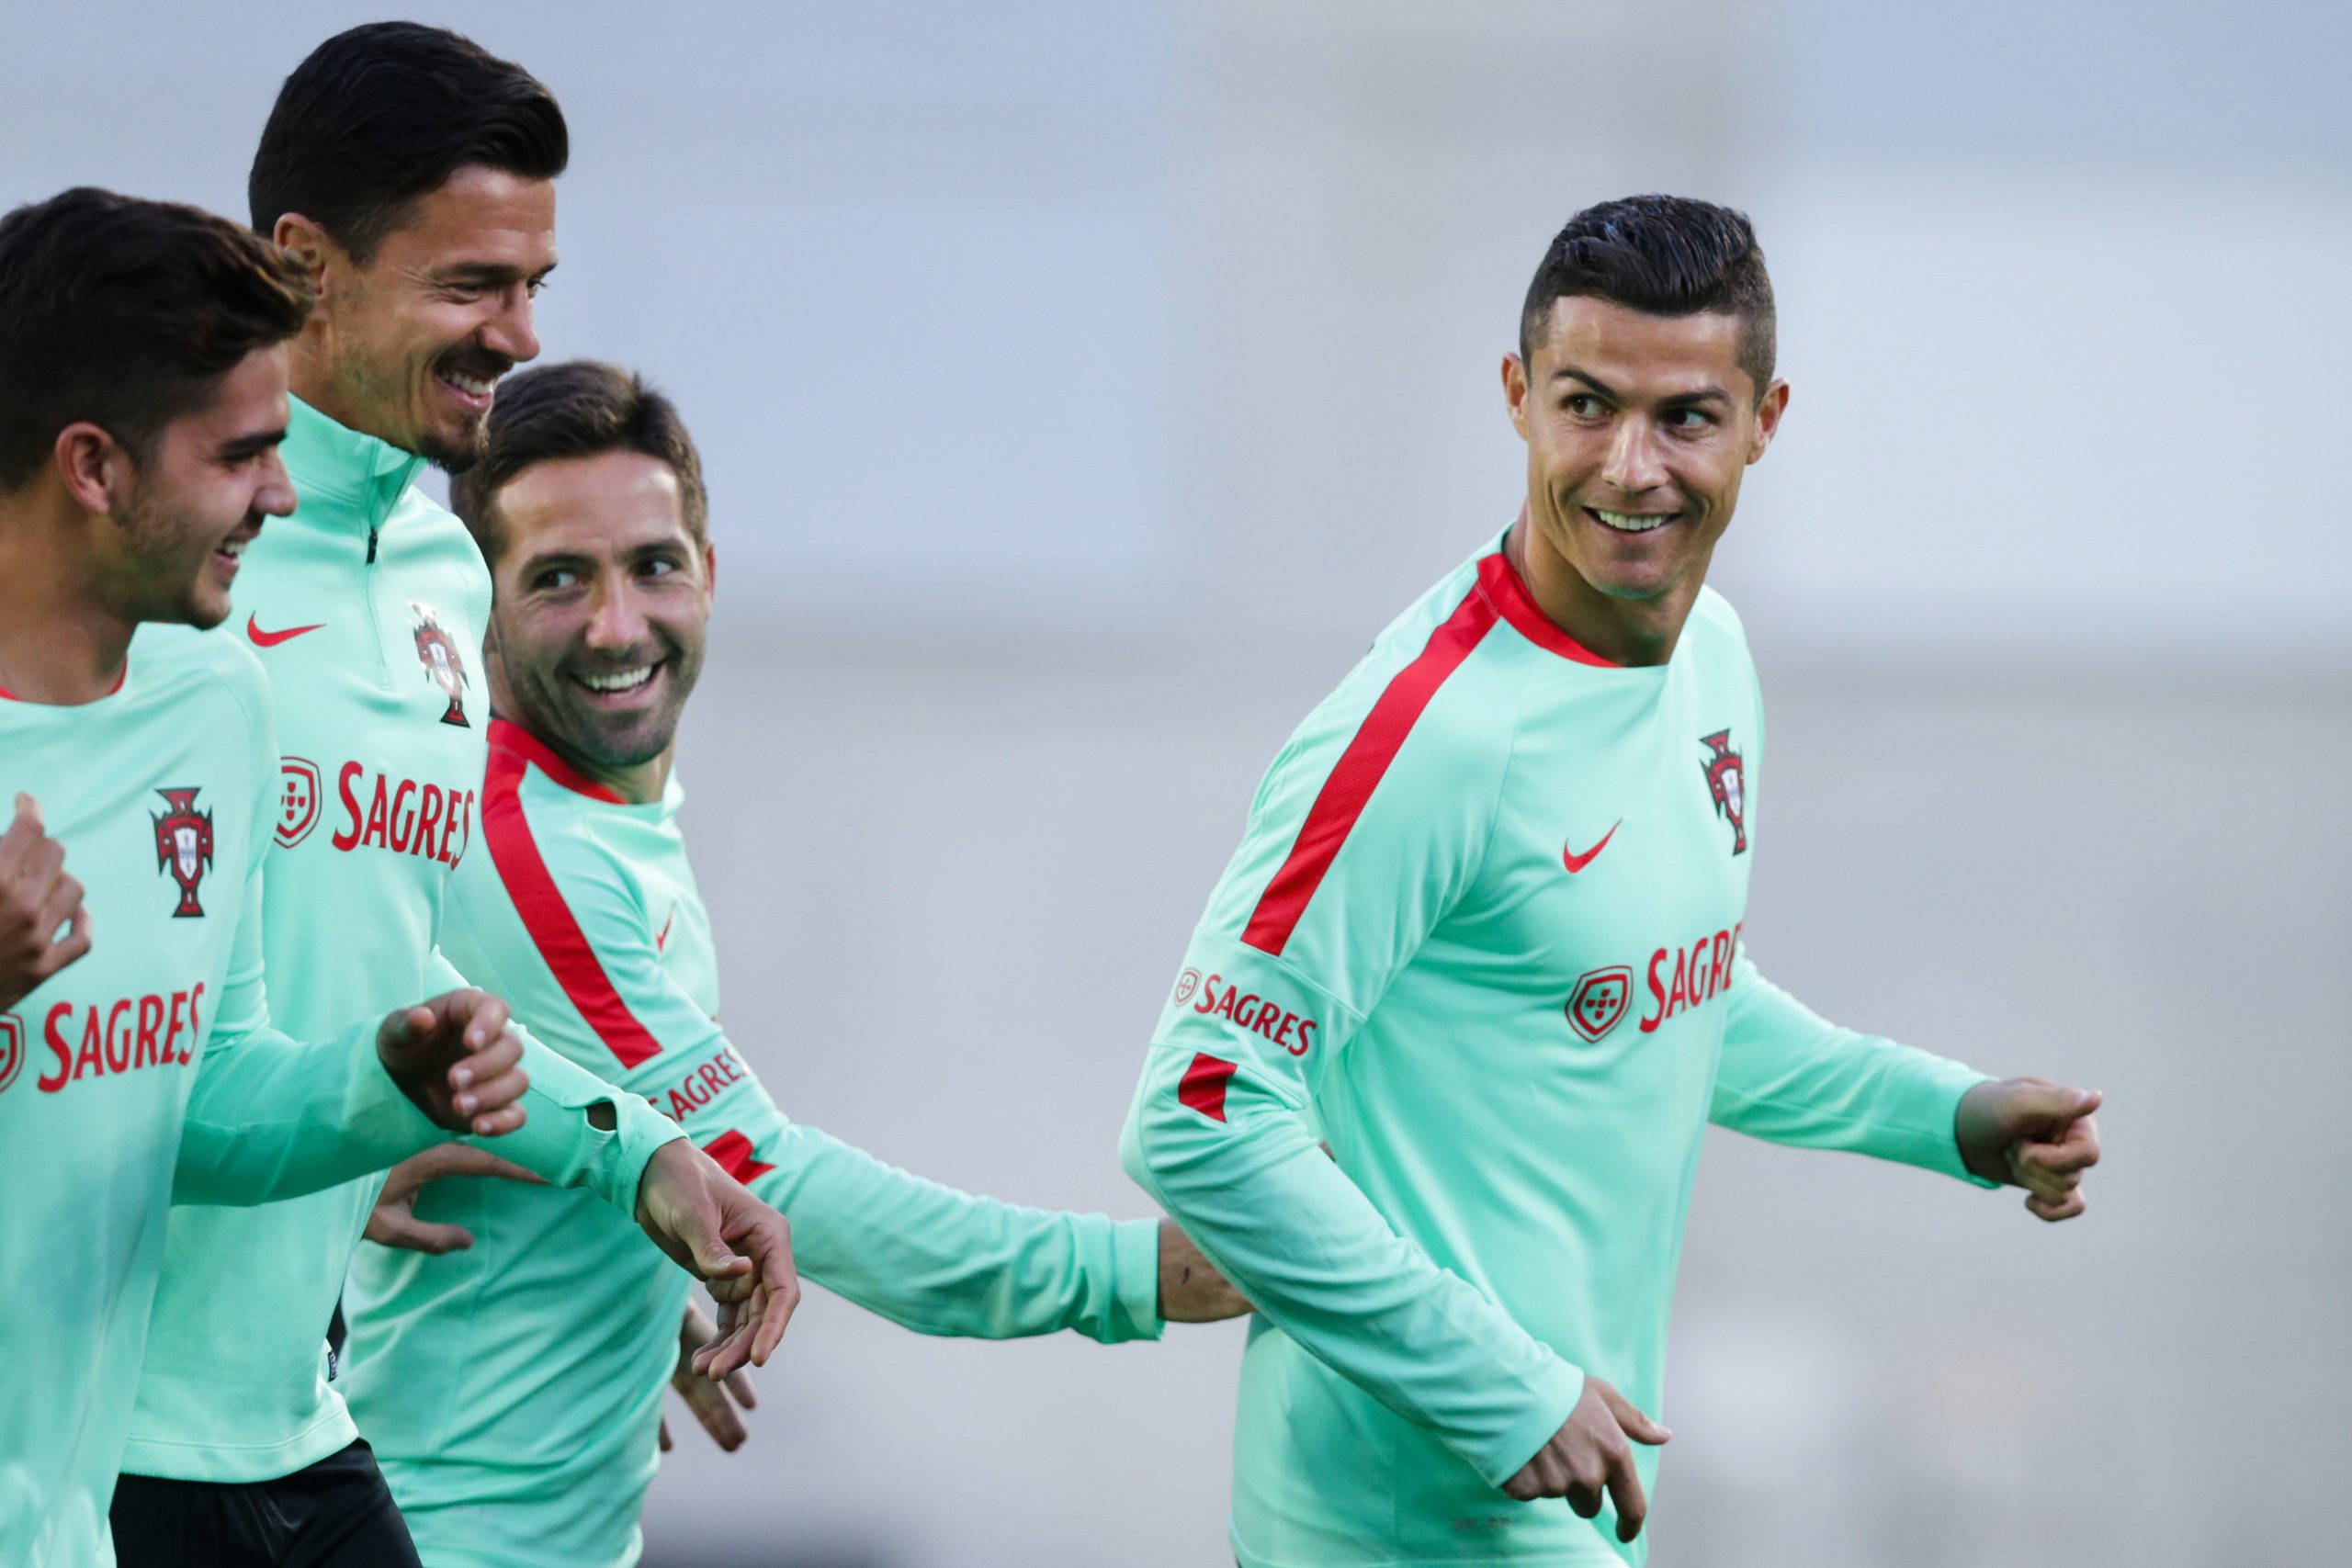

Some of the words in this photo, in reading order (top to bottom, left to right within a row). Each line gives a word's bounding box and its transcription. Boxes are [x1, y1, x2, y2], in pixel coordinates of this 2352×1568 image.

[332, 761, 474, 871] SAGRES
[38, 981, 204, 1093] SAGRES
[1194, 974, 1317, 1056] SAGRES
